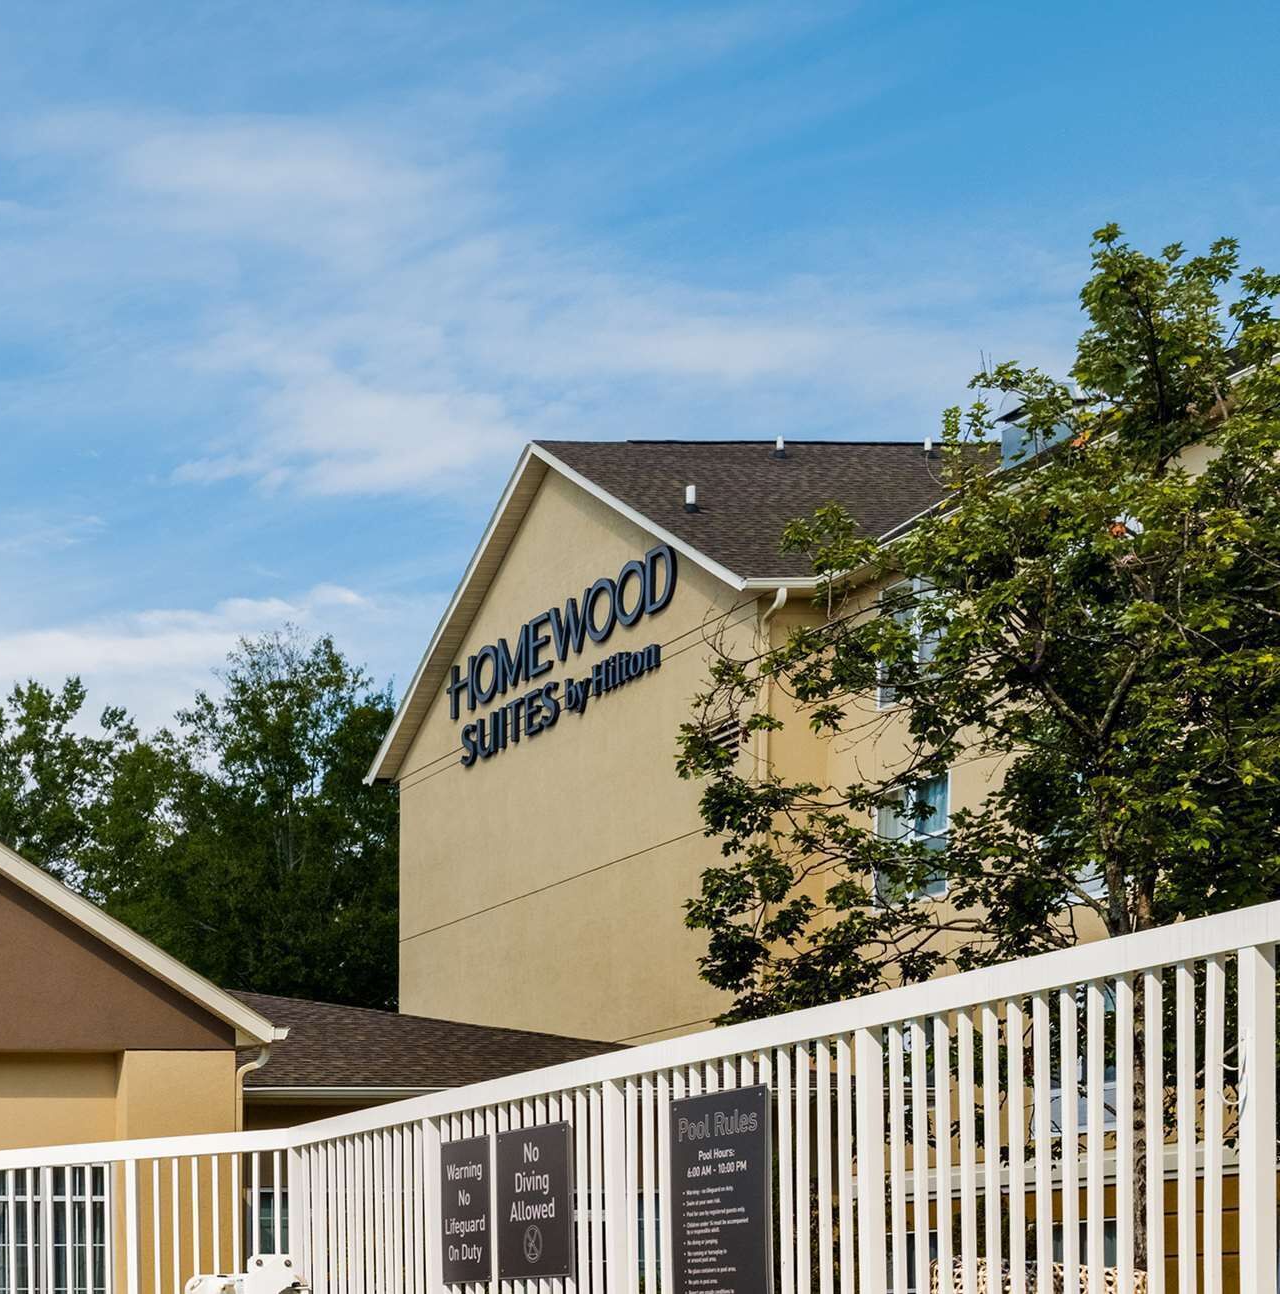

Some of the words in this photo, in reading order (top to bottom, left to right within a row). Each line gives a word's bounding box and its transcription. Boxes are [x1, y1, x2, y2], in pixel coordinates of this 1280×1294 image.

[447, 545, 678, 720] HOMEWOOD
[460, 681, 560, 767] SUITES
[563, 676, 592, 713] by
[591, 643, 661, 697] Hilton
[678, 1114, 710, 1142] Pool
[714, 1109, 758, 1137] Rules
[523, 1142, 539, 1163] No
[698, 1149, 713, 1160] Pool
[713, 1148, 735, 1159] Hours:
[447, 1161, 482, 1181] Warning
[701, 1164, 711, 1176] AM
[736, 1160, 747, 1171] PM
[515, 1170, 549, 1196] Diving
[458, 1189, 471, 1206] No
[510, 1197, 555, 1222] Allowed
[445, 1214, 486, 1237] Lifeguard
[448, 1245, 459, 1261] On
[461, 1243, 482, 1263] Duty
